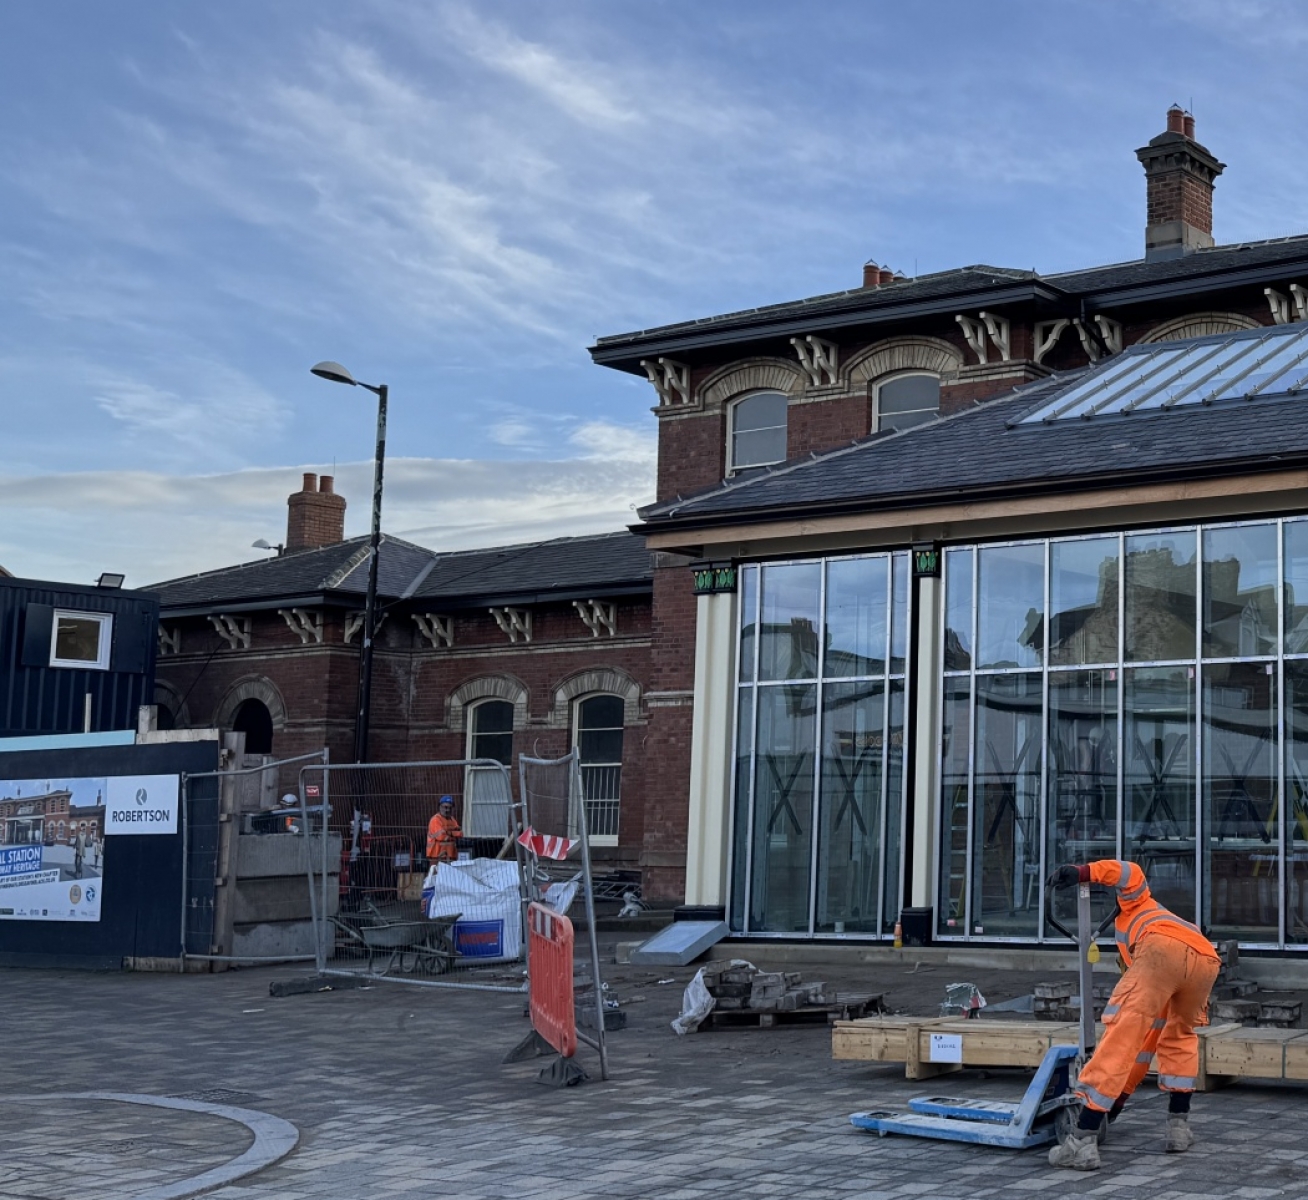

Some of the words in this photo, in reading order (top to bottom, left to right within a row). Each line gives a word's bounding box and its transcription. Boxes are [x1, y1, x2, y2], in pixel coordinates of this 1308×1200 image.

[112, 809, 170, 823] ROBERTSON
[8, 847, 41, 863] STATION
[13, 860, 41, 873] HERITAGE
